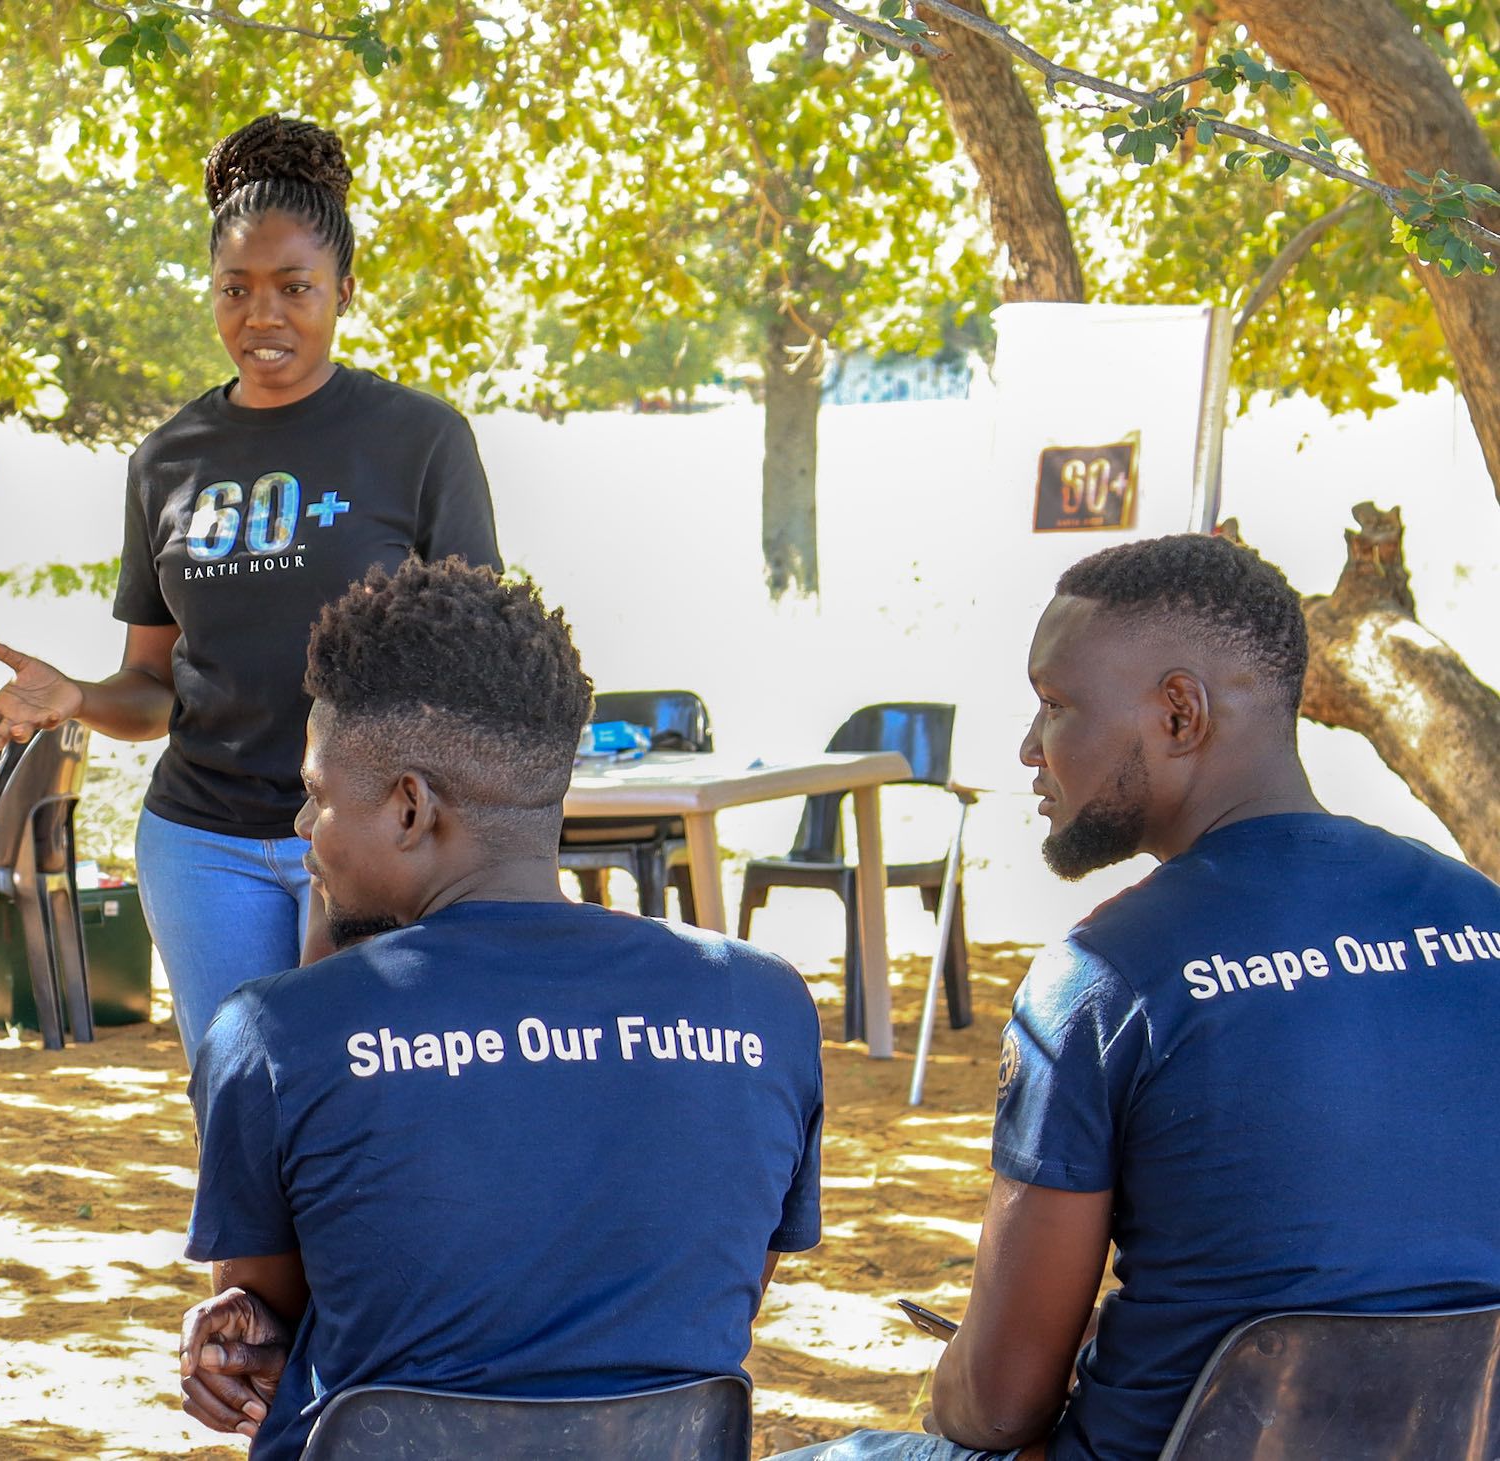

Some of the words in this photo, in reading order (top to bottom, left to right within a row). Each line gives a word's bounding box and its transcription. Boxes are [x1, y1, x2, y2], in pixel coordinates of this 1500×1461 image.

[185, 471, 350, 562] 60+
[184, 562, 239, 580] EARTH
[249, 555, 306, 573] HOUR
[1183, 950, 1330, 1000] Shape
[1335, 935, 1407, 975] Our
[347, 1028, 505, 1077] Shape
[517, 1017, 603, 1062] Our
[617, 1016, 764, 1068] Future
